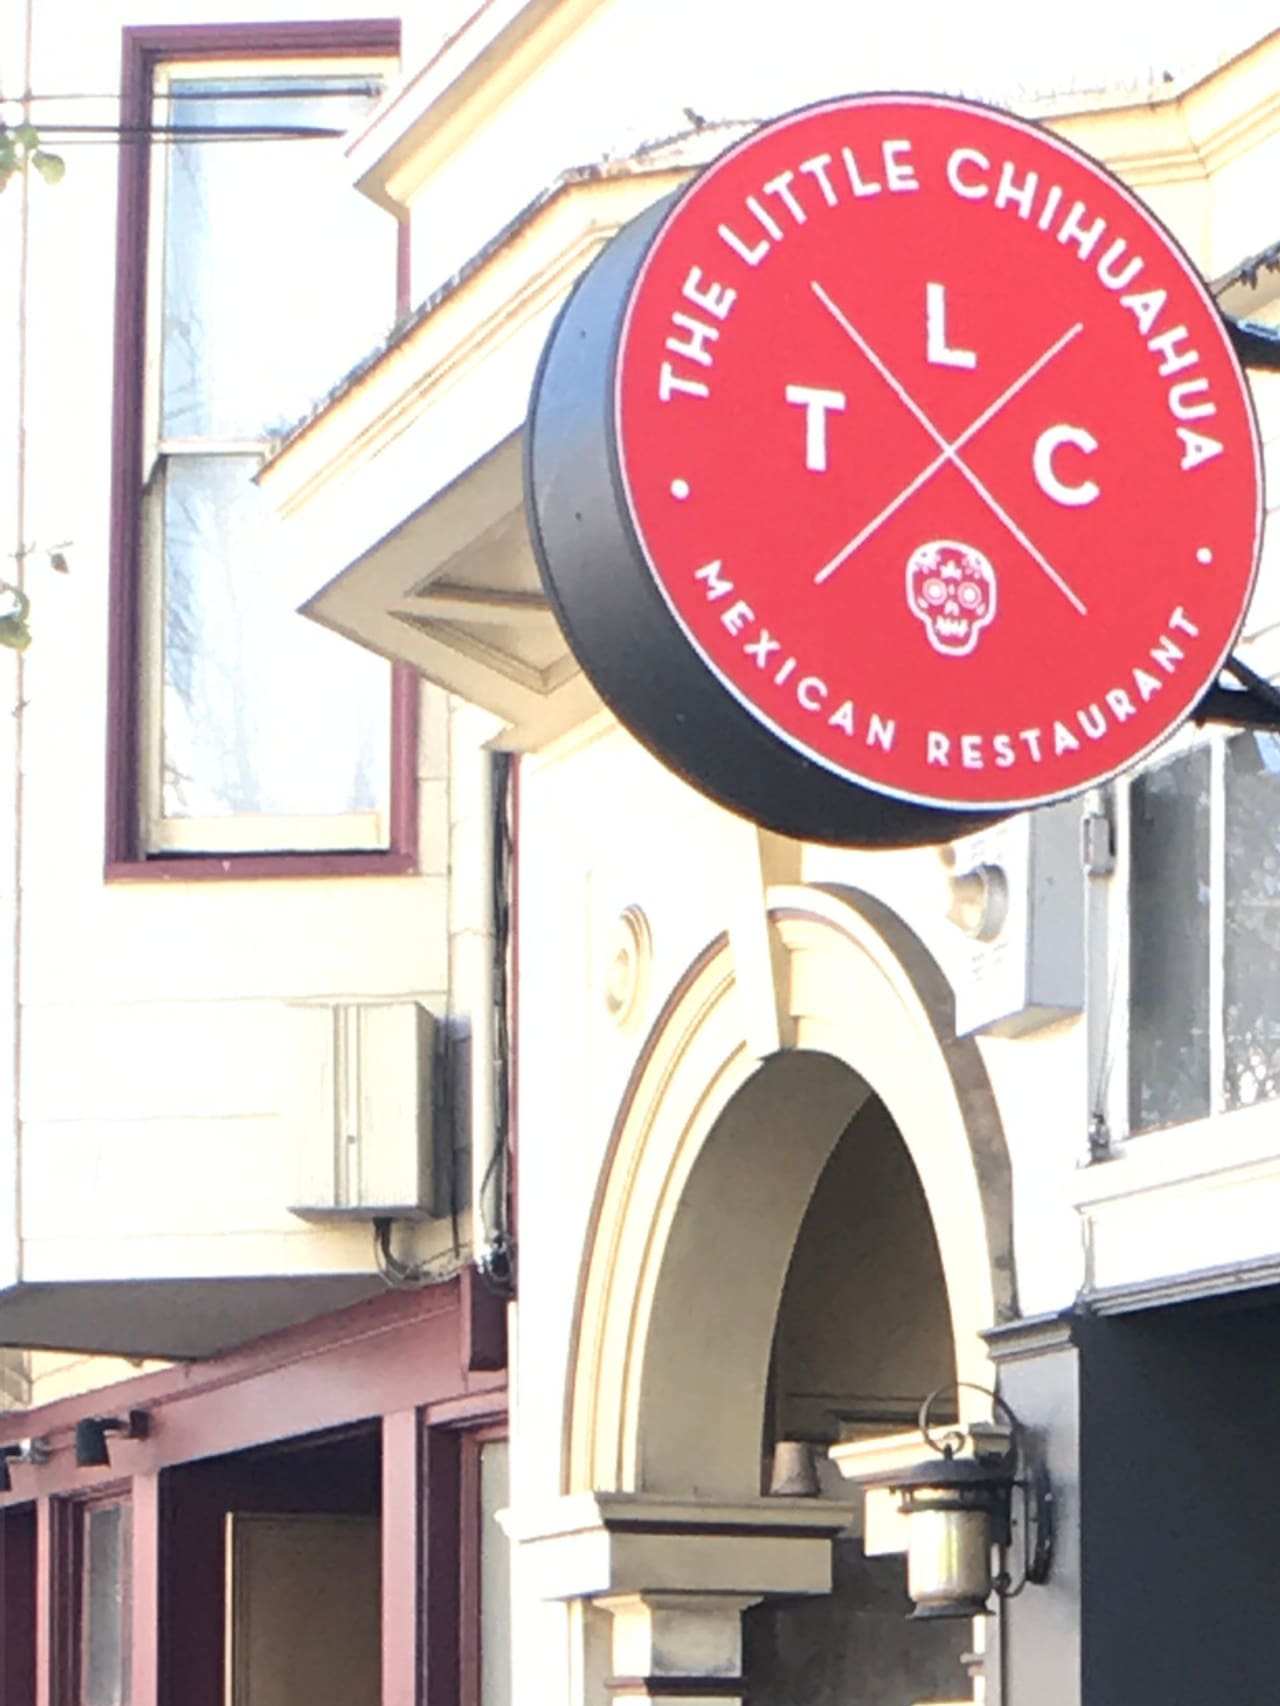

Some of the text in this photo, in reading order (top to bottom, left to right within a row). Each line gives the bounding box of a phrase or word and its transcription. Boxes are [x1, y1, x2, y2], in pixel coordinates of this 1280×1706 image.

[658, 139, 1224, 471] THE LITTLE CHIHUAHUA
[926, 282, 977, 369] L
[785, 384, 1100, 505] T C
[694, 559, 1199, 769] MEXICAN RESTAURANT
